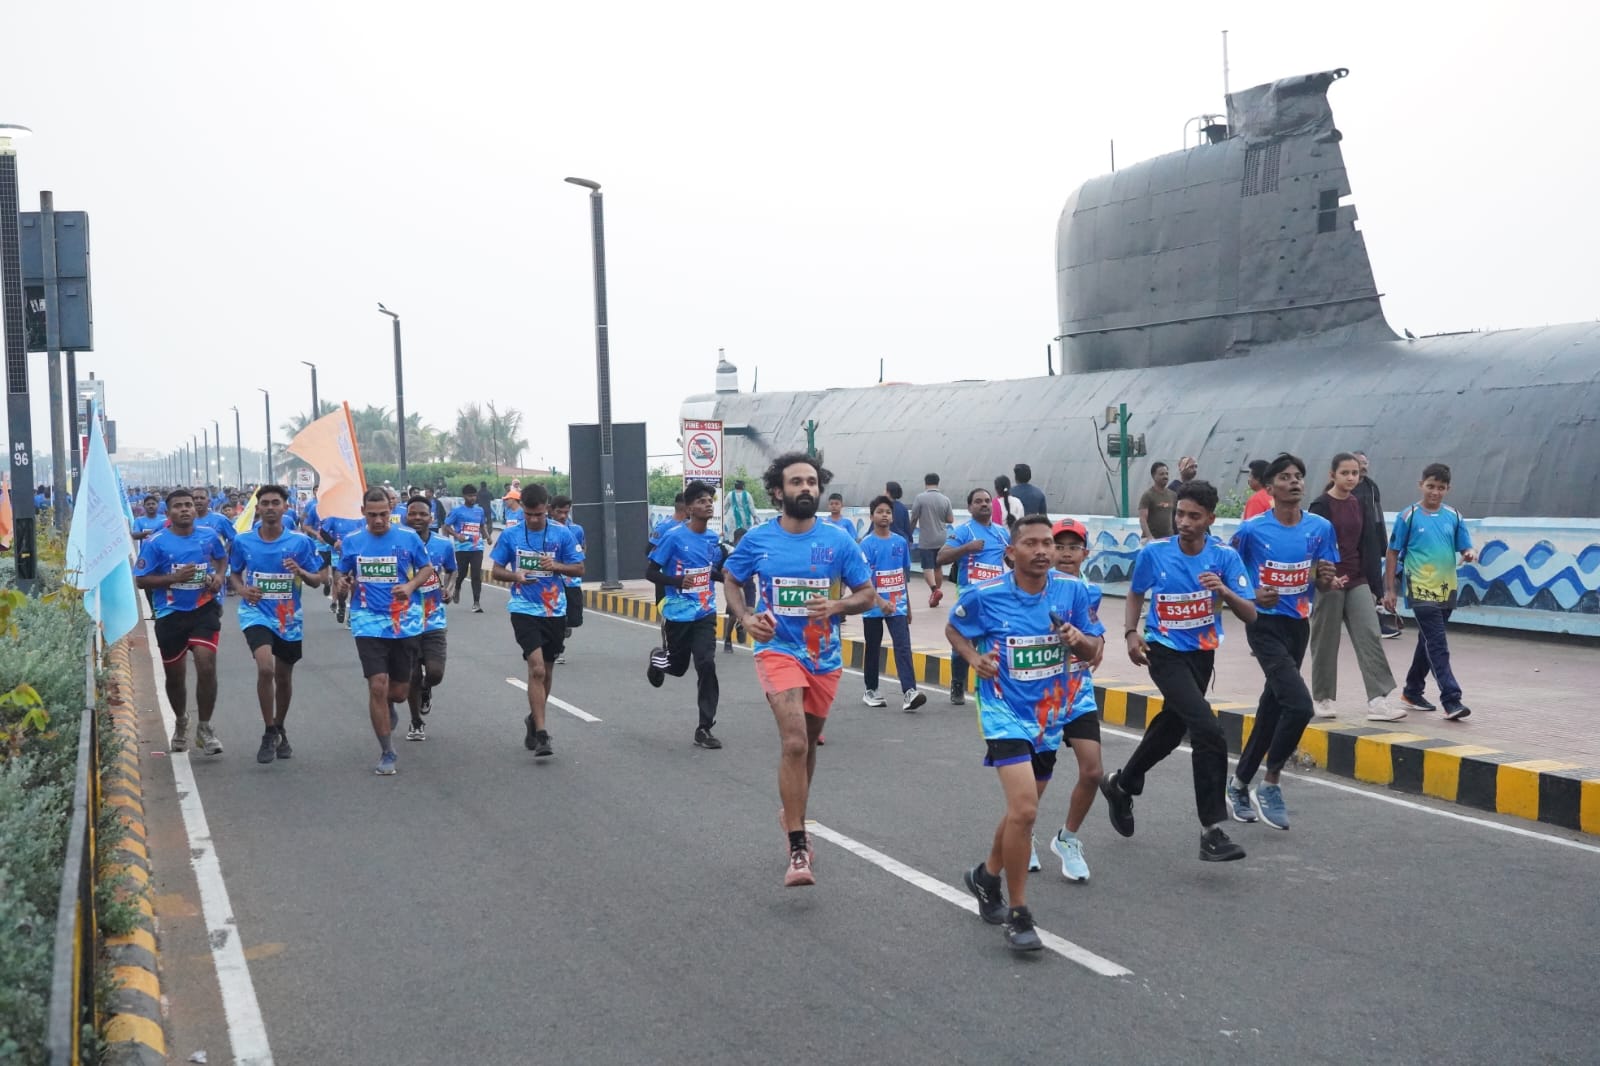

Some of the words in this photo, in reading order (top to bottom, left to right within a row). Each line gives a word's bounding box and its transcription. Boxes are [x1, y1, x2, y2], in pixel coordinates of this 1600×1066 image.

[14, 453, 29, 466] 96
[361, 565, 392, 575] 14148
[1270, 571, 1305, 583] 53411
[257, 581, 289, 591] 11055
[1166, 602, 1207, 616] 53414
[1015, 647, 1060, 665] 11104
